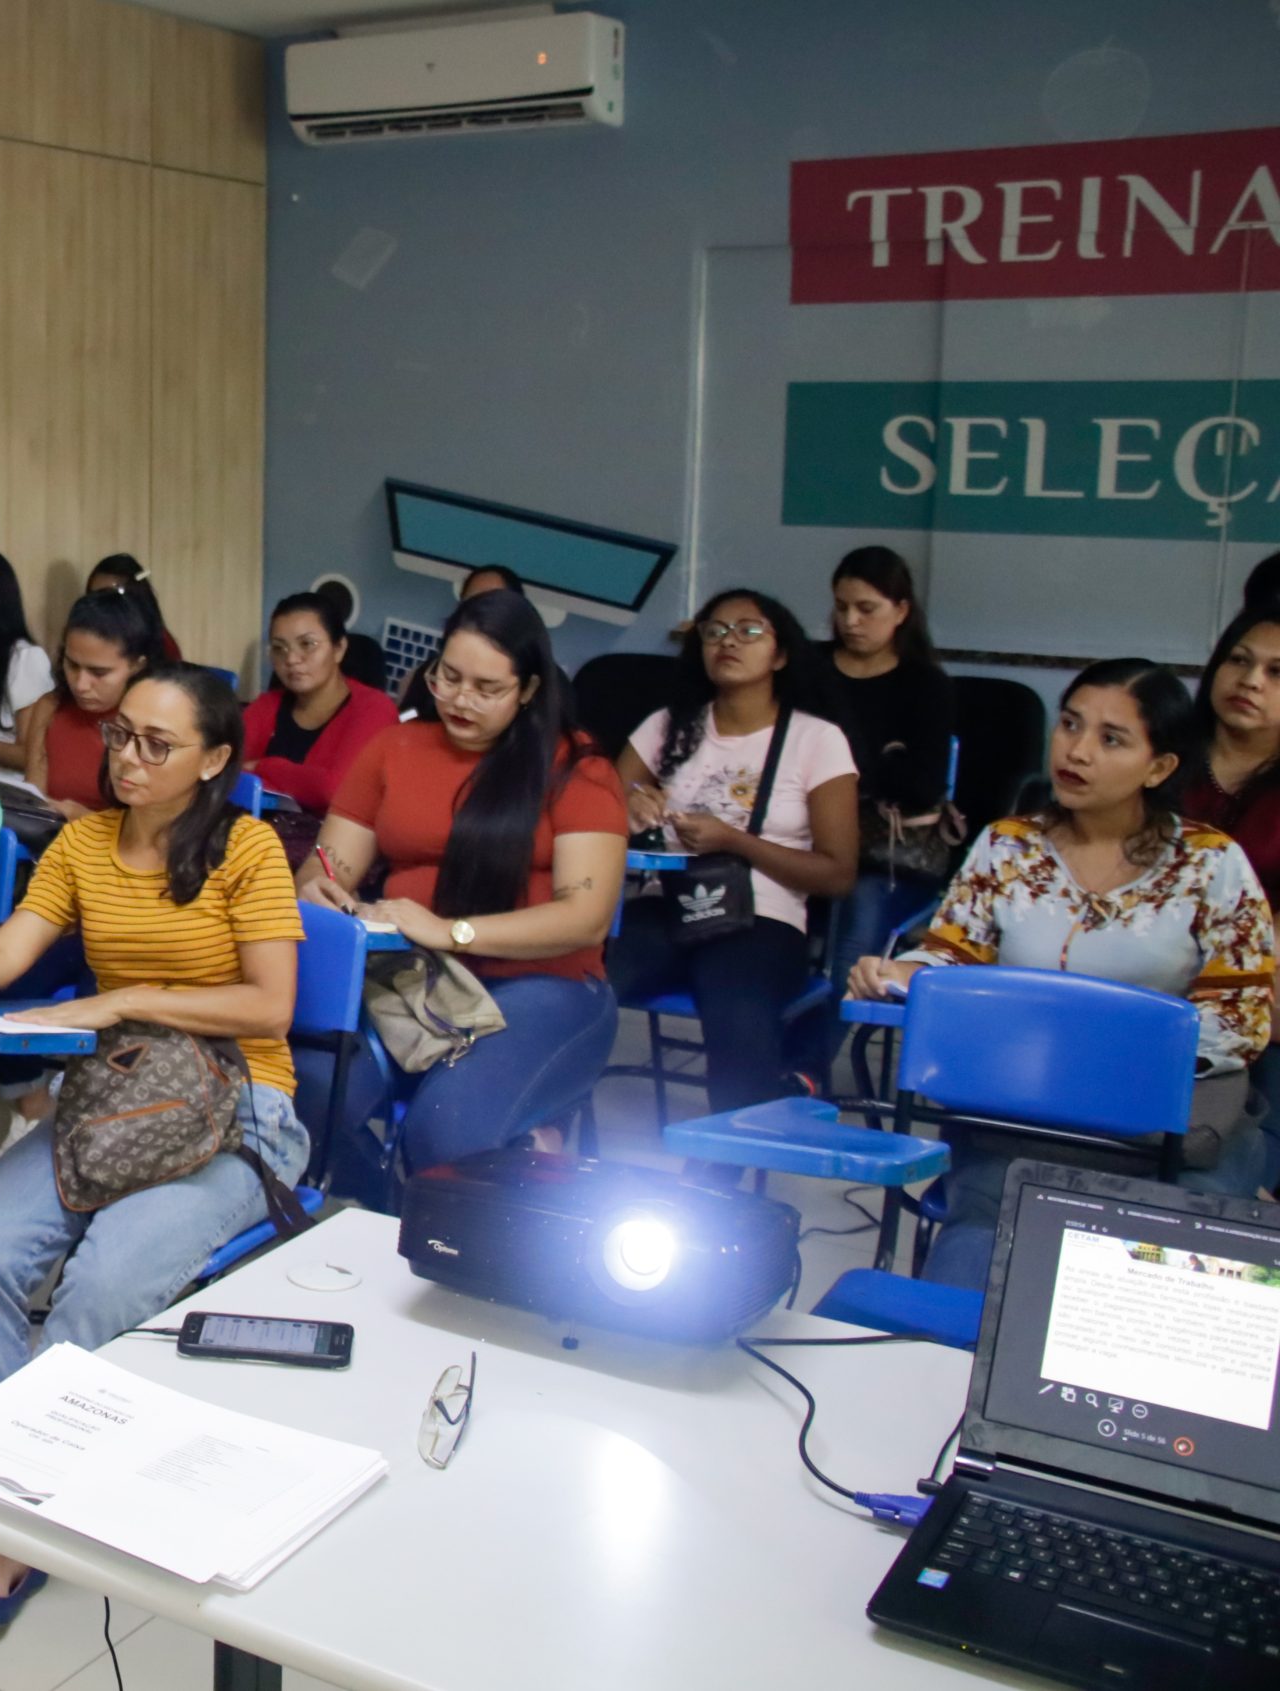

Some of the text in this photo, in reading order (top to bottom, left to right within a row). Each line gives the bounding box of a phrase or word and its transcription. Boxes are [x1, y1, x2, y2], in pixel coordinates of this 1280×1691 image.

[846, 164, 1280, 268] TREINA
[879, 414, 1280, 527] SELEÇ
[682, 908, 726, 923] adidas
[60, 1395, 128, 1425] AMAZONAS
